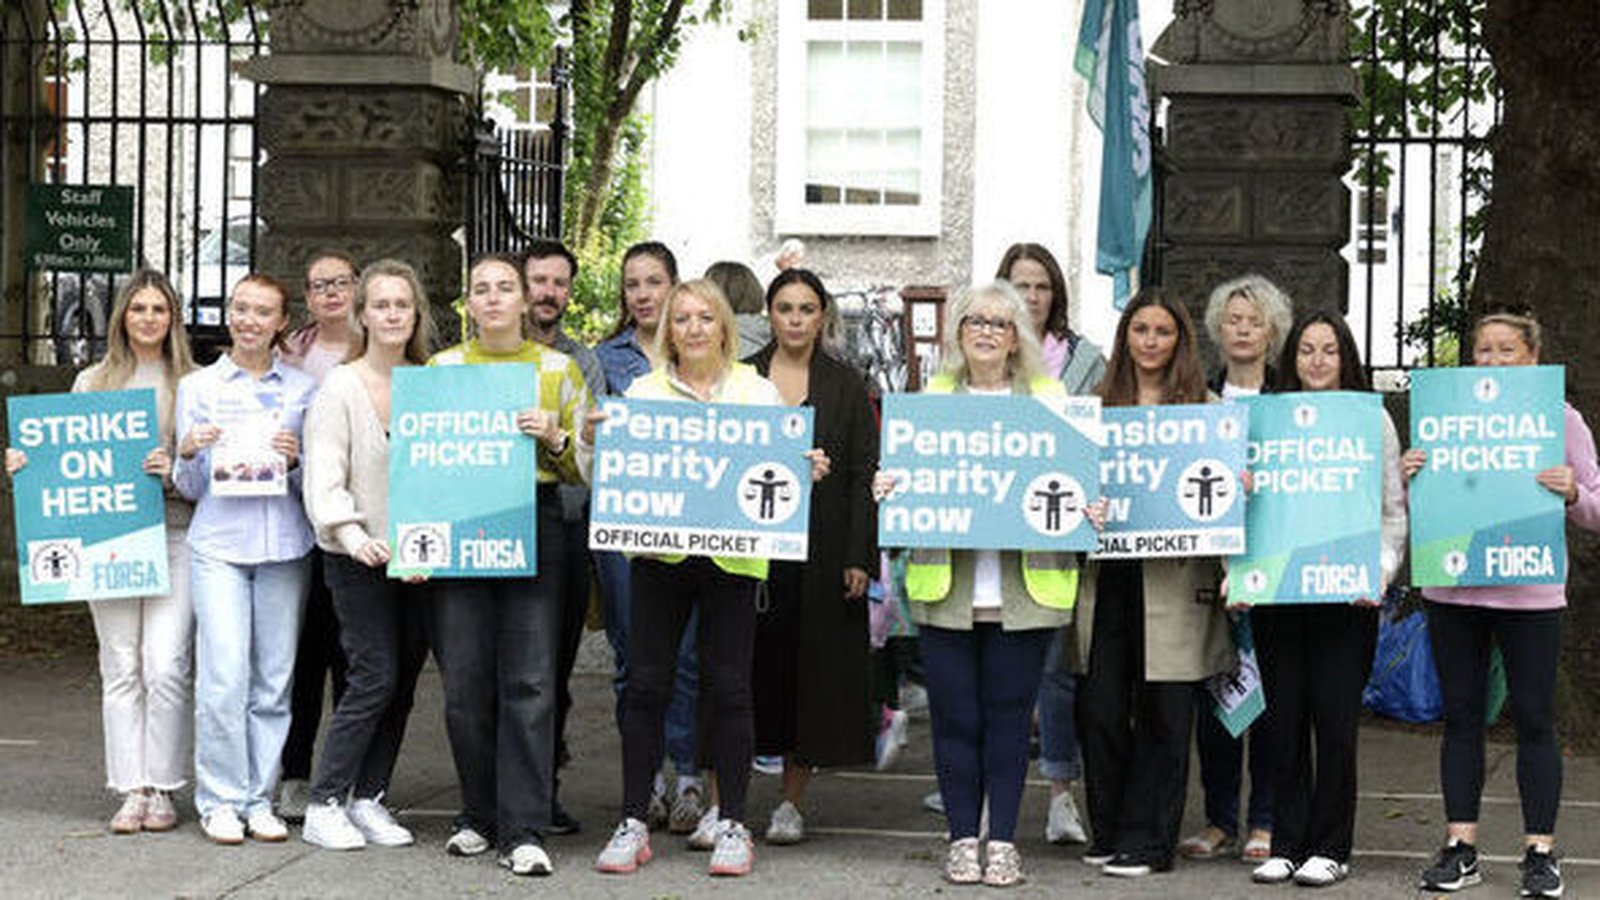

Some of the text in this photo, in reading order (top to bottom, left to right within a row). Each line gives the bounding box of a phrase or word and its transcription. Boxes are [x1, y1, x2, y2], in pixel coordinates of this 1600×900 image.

[61, 189, 103, 205] Staff
[45, 210, 116, 229] Vehicles
[59, 234, 100, 252] Only
[19, 410, 150, 447] STRIKE
[602, 401, 771, 445] Pension
[1101, 411, 1206, 446] nsion
[1418, 413, 1556, 441] OFFICIAL
[886, 419, 1056, 458] Pension
[1247, 437, 1374, 465] OFFICIAL
[60, 448, 113, 479] ON
[410, 440, 515, 467] PICKET
[599, 445, 731, 489] parity
[1432, 445, 1541, 472] PICKET
[1100, 450, 1168, 492] rity
[1253, 466, 1360, 493] PICKET
[42, 483, 138, 517] HERE
[597, 487, 685, 517] now
[885, 505, 973, 534] now
[594, 528, 684, 549] OFFICIAL
[688, 534, 760, 553] PICKET
[1135, 535, 1199, 553] PICKET
